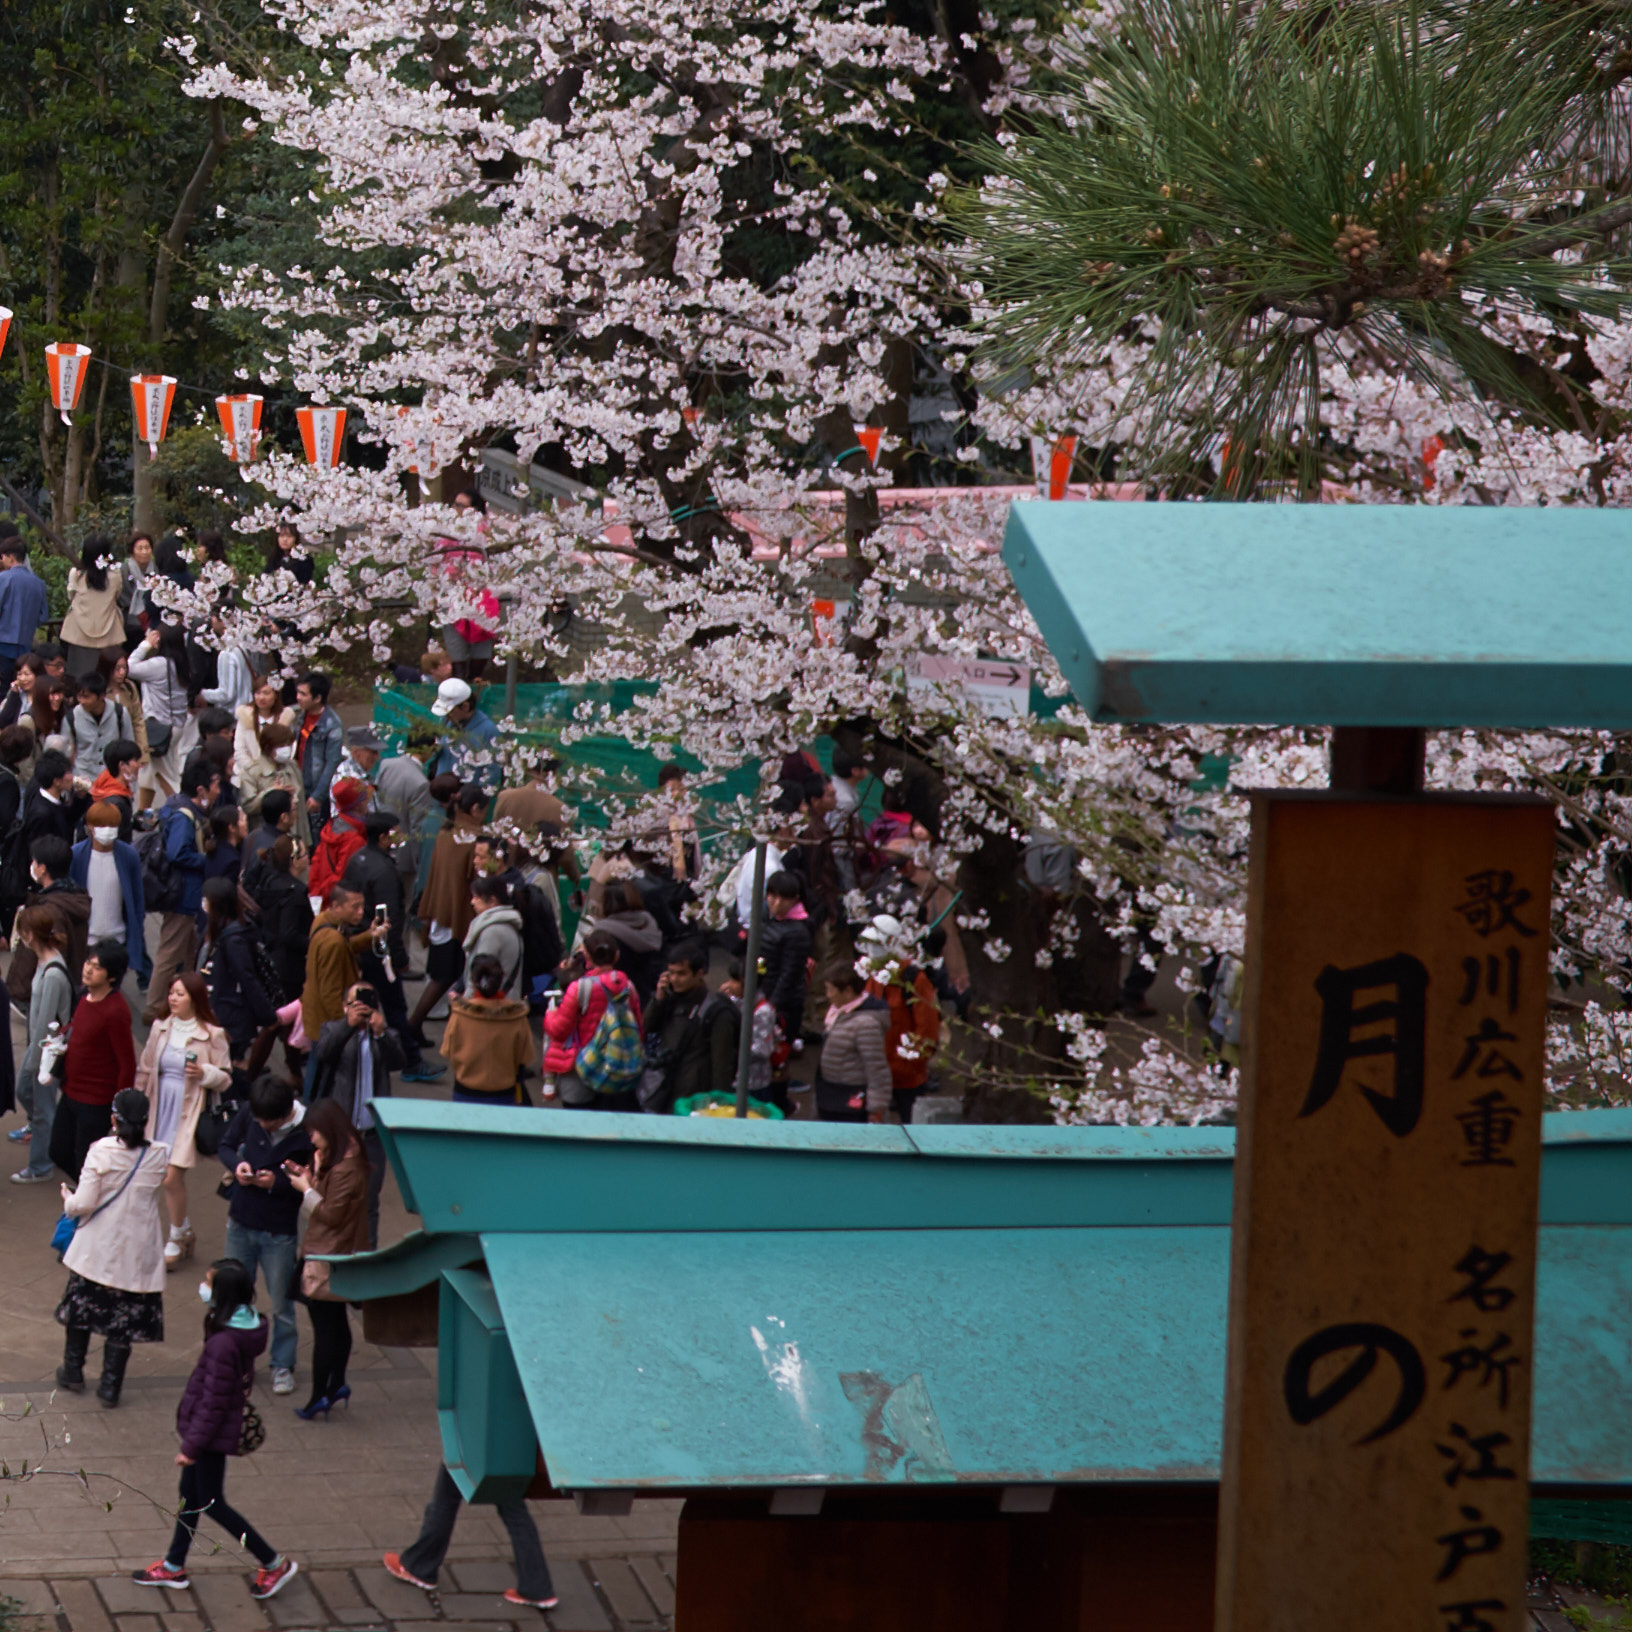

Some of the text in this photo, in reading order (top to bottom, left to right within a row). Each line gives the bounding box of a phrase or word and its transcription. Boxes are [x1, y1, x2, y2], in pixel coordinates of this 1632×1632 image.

[1284, 951, 1431, 1446] 月の
[1450, 869, 1540, 1168] 歌川広重
